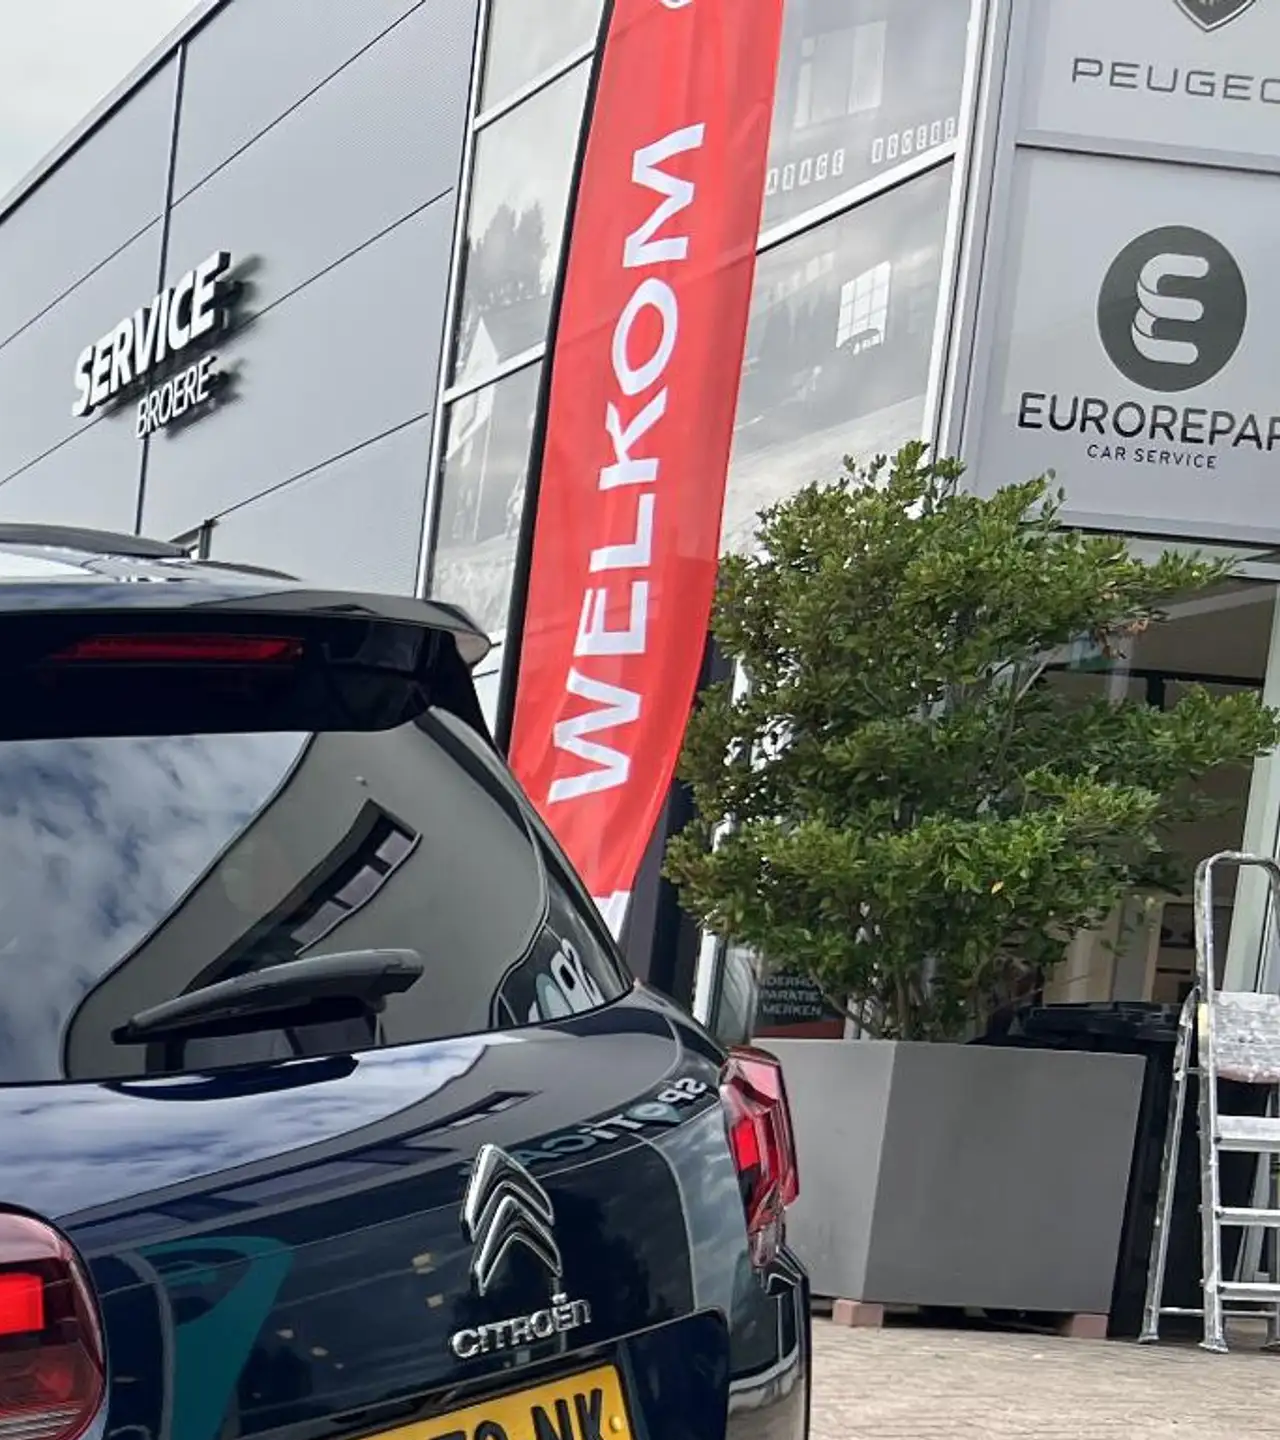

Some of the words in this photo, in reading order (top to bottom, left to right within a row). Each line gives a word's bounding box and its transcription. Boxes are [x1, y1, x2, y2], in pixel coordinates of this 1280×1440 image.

[72, 250, 229, 417] SERVICE
[135, 356, 216, 439] BROERE
[1087, 443, 1127, 463] CAR
[1133, 447, 1218, 470] SERVICE
[546, 122, 705, 805] WELKOM
